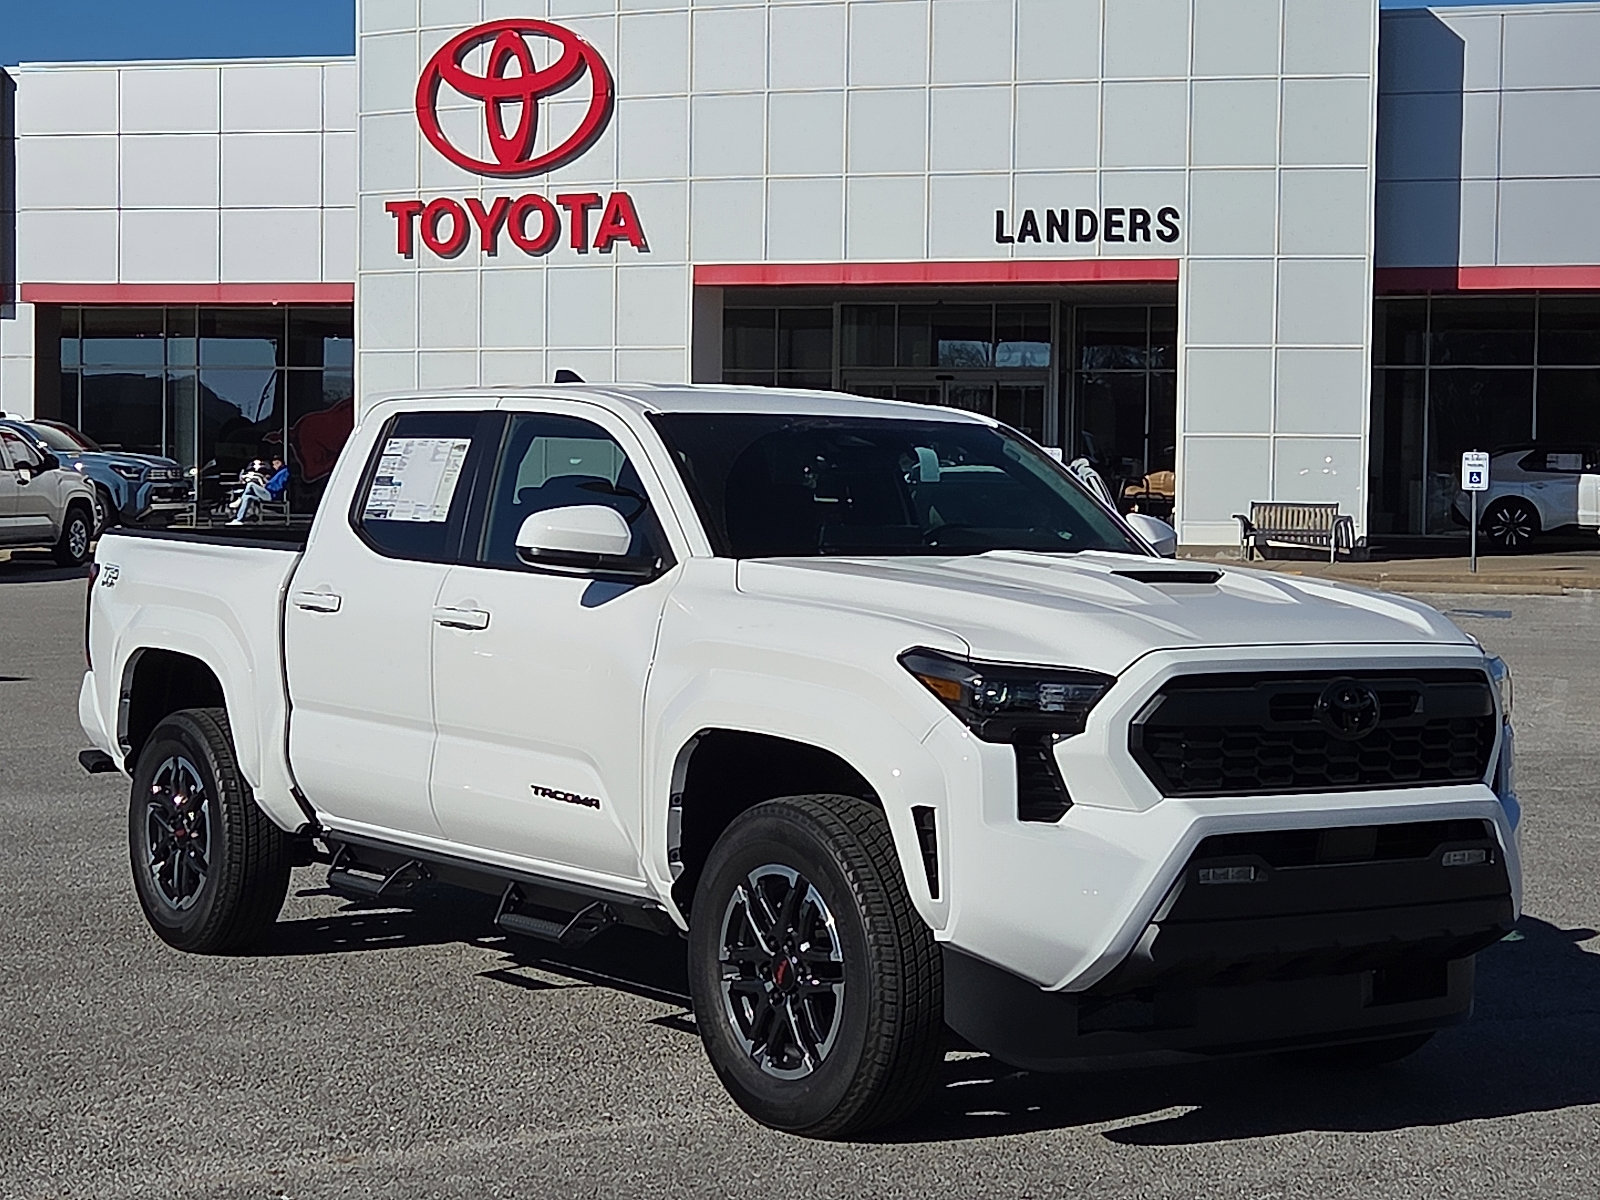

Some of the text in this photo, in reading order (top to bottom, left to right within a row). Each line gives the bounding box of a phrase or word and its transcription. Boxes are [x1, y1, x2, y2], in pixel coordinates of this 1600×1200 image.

[385, 192, 650, 258] TOYOTA
[995, 206, 1181, 244] LANDERS
[530, 784, 600, 810] TACOMA
